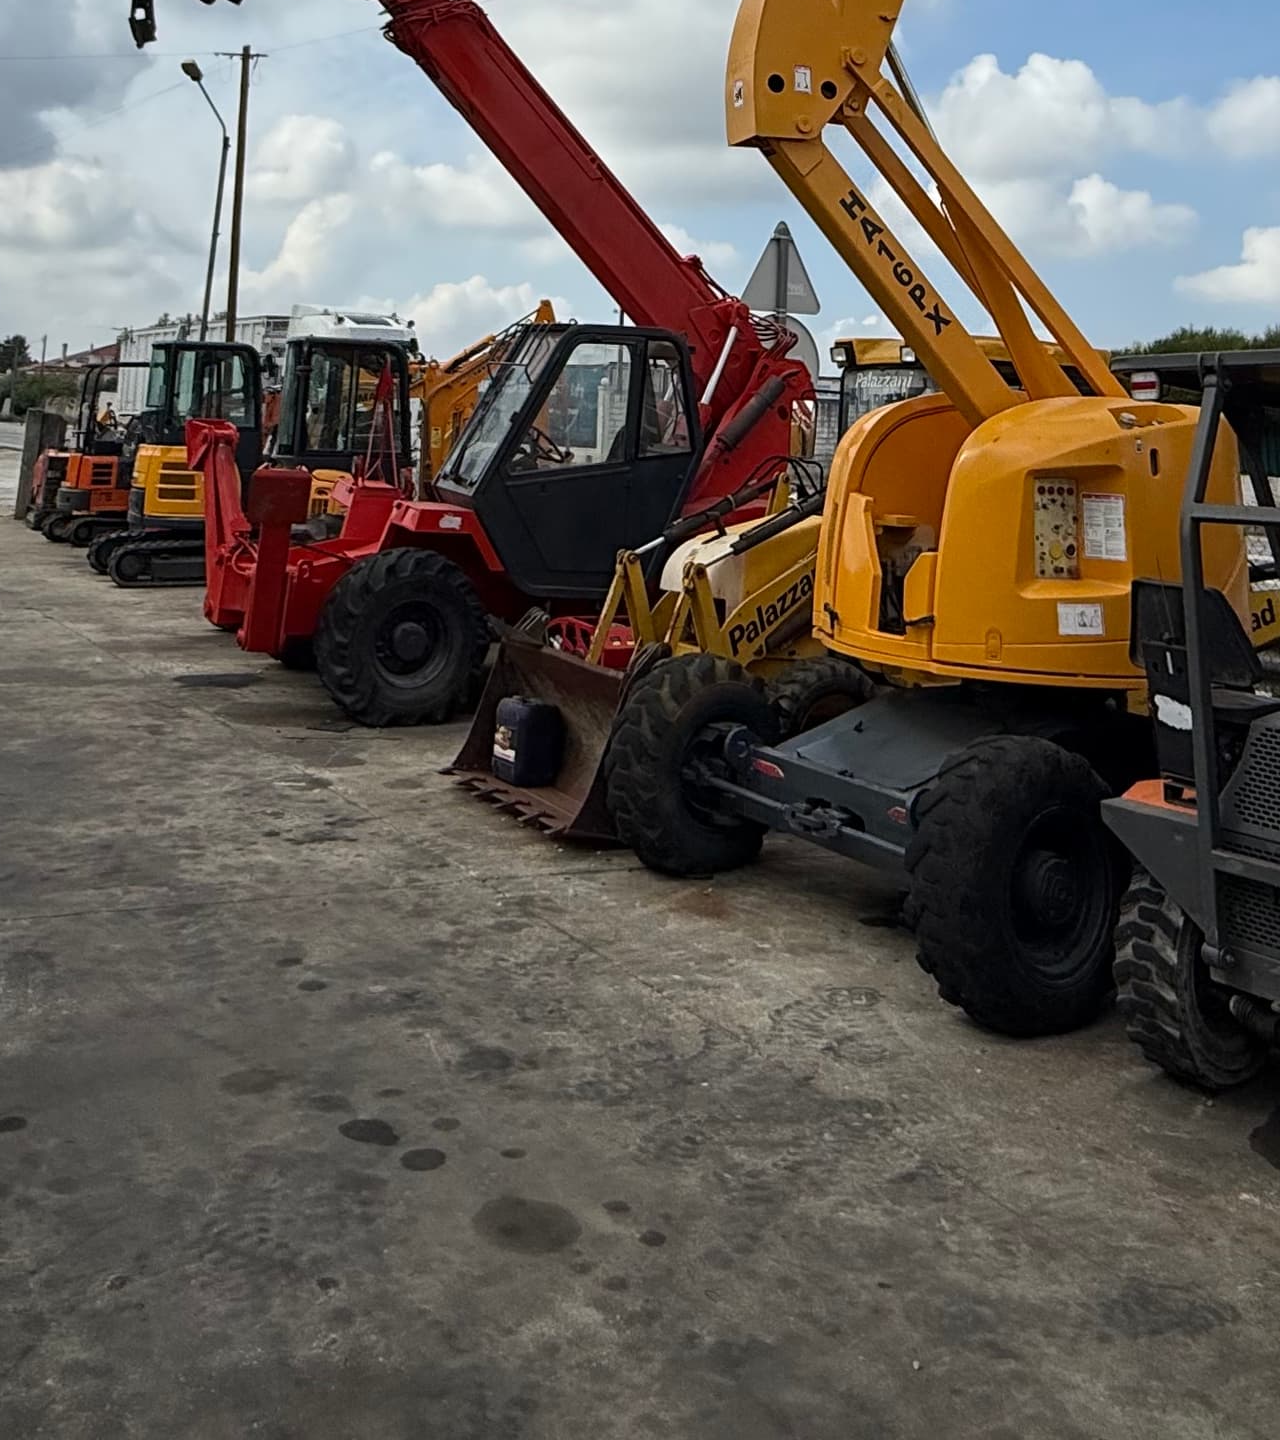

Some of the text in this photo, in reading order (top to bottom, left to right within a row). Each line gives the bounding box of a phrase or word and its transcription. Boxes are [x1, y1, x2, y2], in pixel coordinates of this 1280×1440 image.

[839, 189, 952, 336] HA16PX
[855, 371, 914, 389] Palazzani
[728, 568, 816, 658] Palazza
